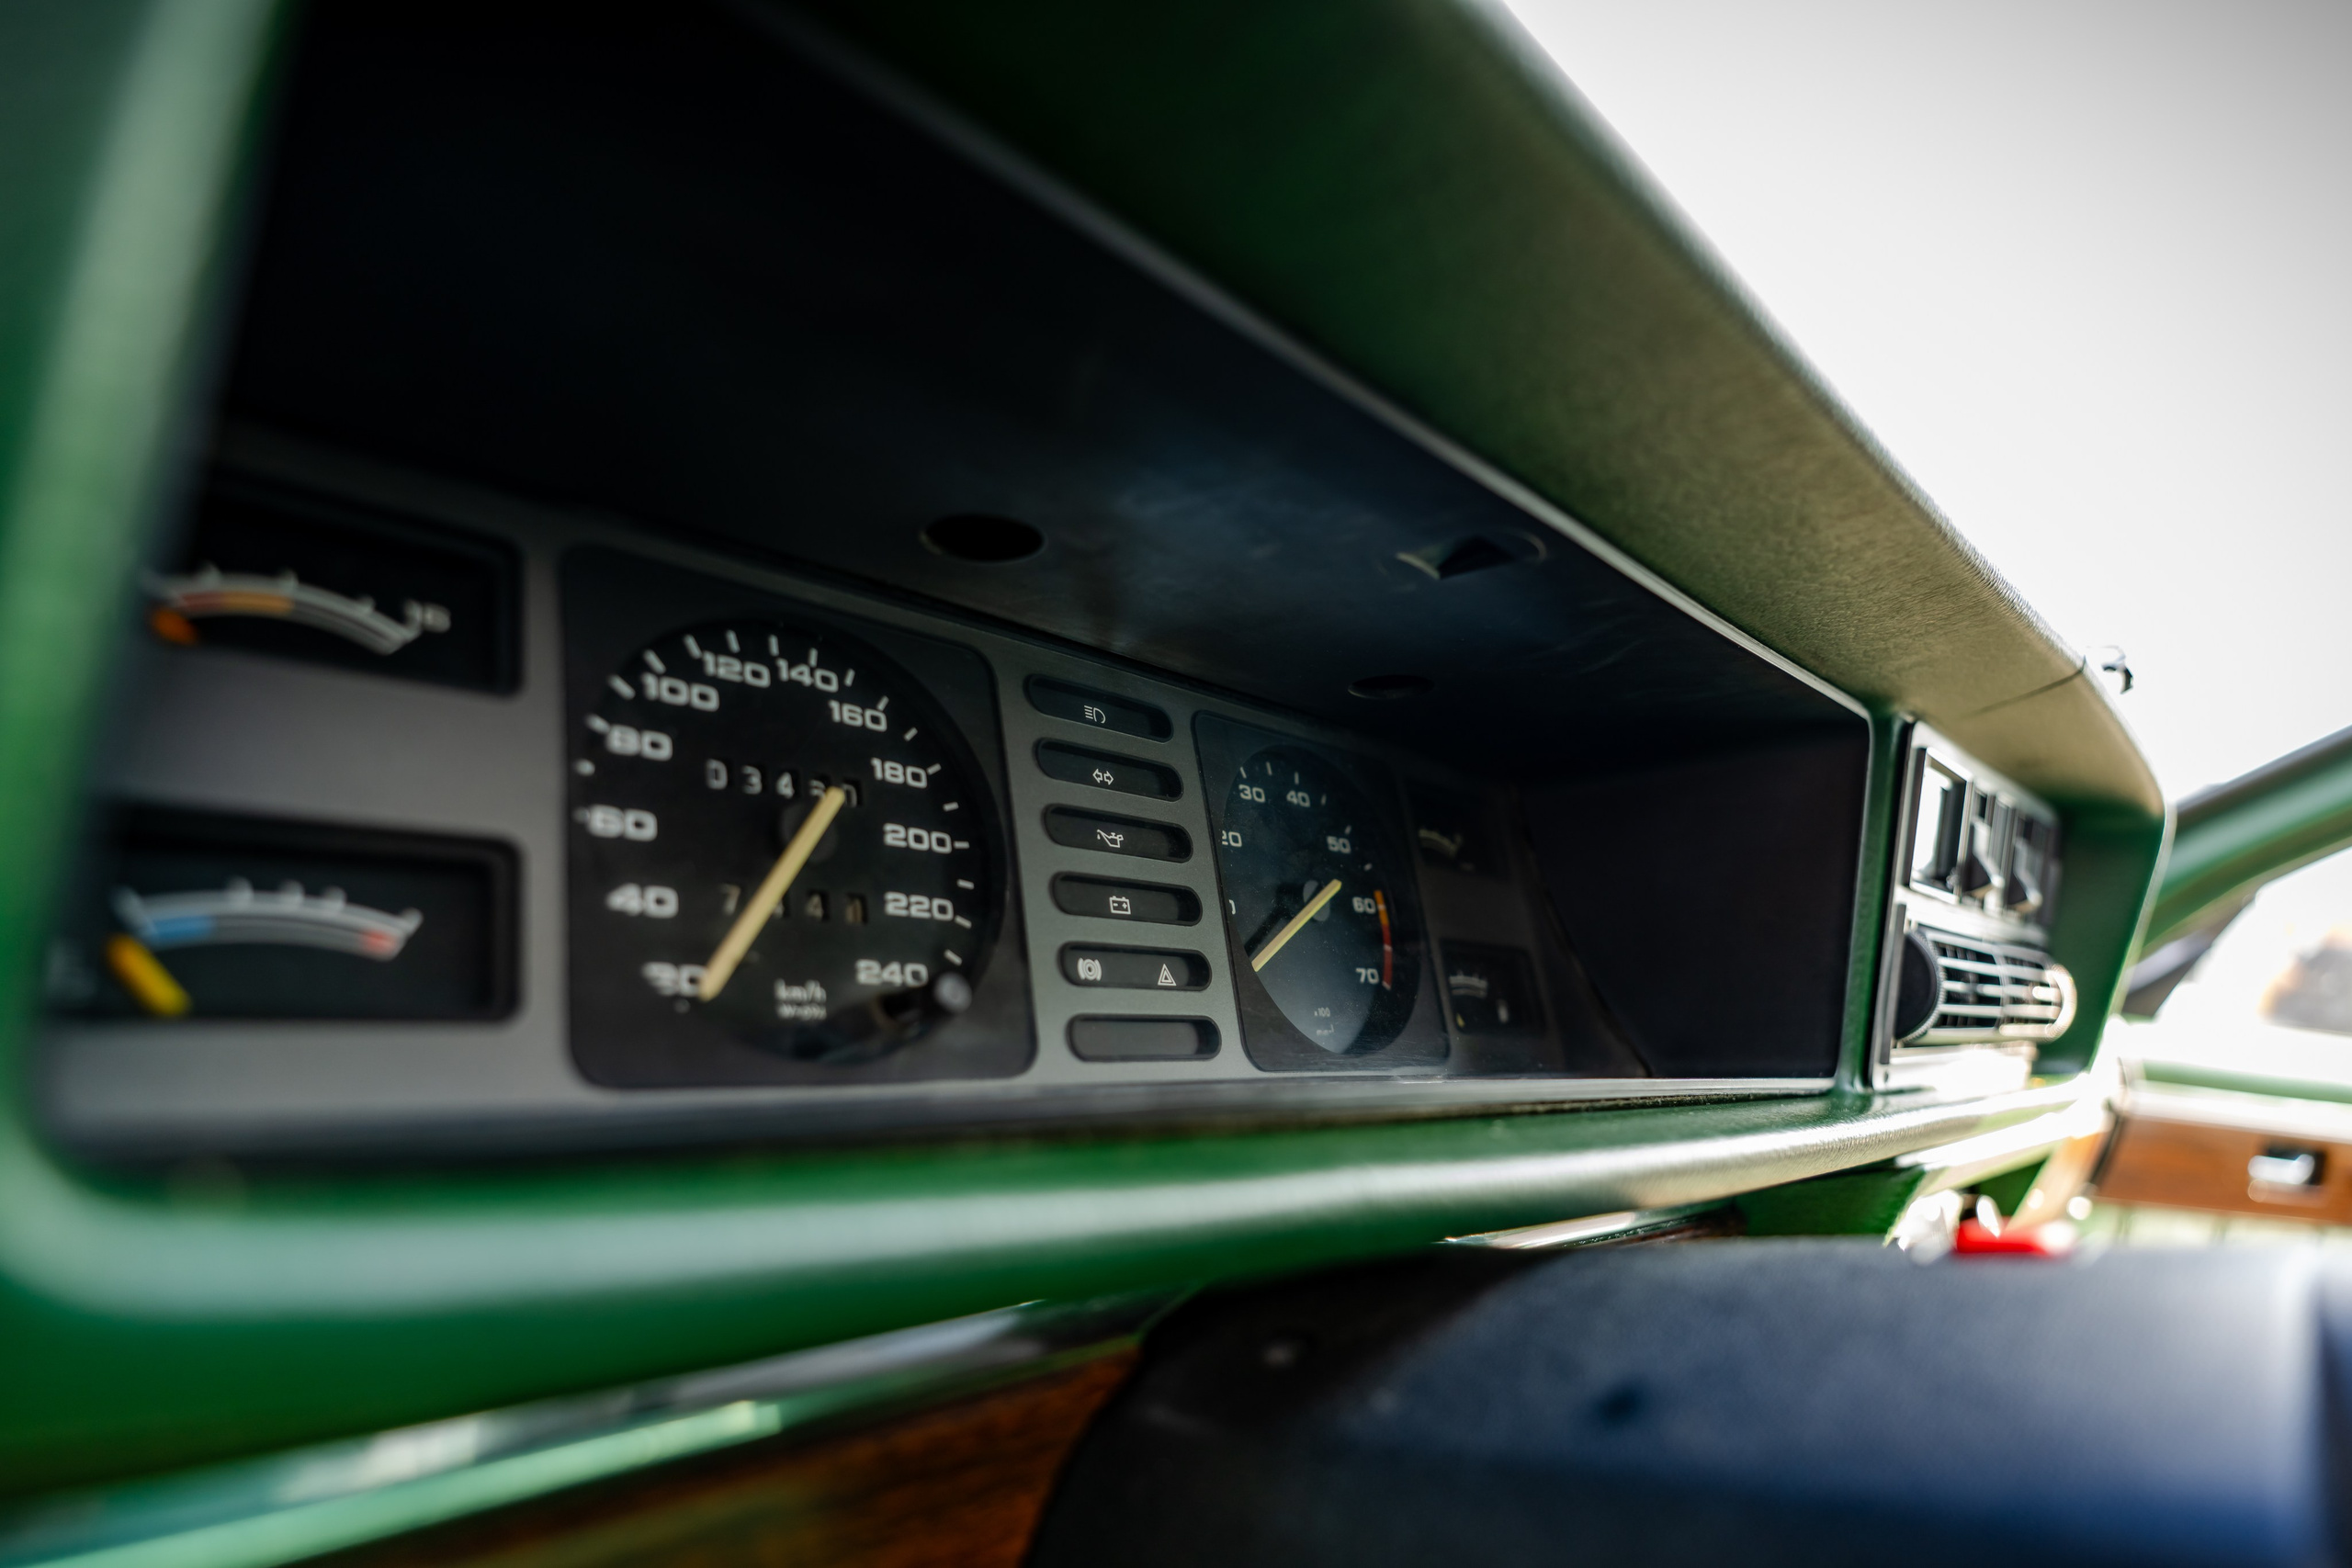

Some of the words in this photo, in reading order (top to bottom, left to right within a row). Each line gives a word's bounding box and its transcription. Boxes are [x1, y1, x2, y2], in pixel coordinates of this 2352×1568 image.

[702, 652, 772, 687] 120
[775, 658, 840, 693] 140
[642, 672, 720, 713] 100
[829, 700, 888, 732] 160
[606, 725, 673, 762] 80
[871, 756, 927, 789] 180
[1238, 784, 1265, 803] 30
[1286, 790, 1310, 808] 40
[588, 805, 658, 842] 60
[884, 822, 953, 853] 200
[1326, 834, 1351, 854] 50
[606, 883, 679, 919] 40
[885, 891, 954, 921] 220
[1351, 896, 1376, 915] 60
[856, 959, 928, 987] 240
[1355, 967, 1379, 986] 70
